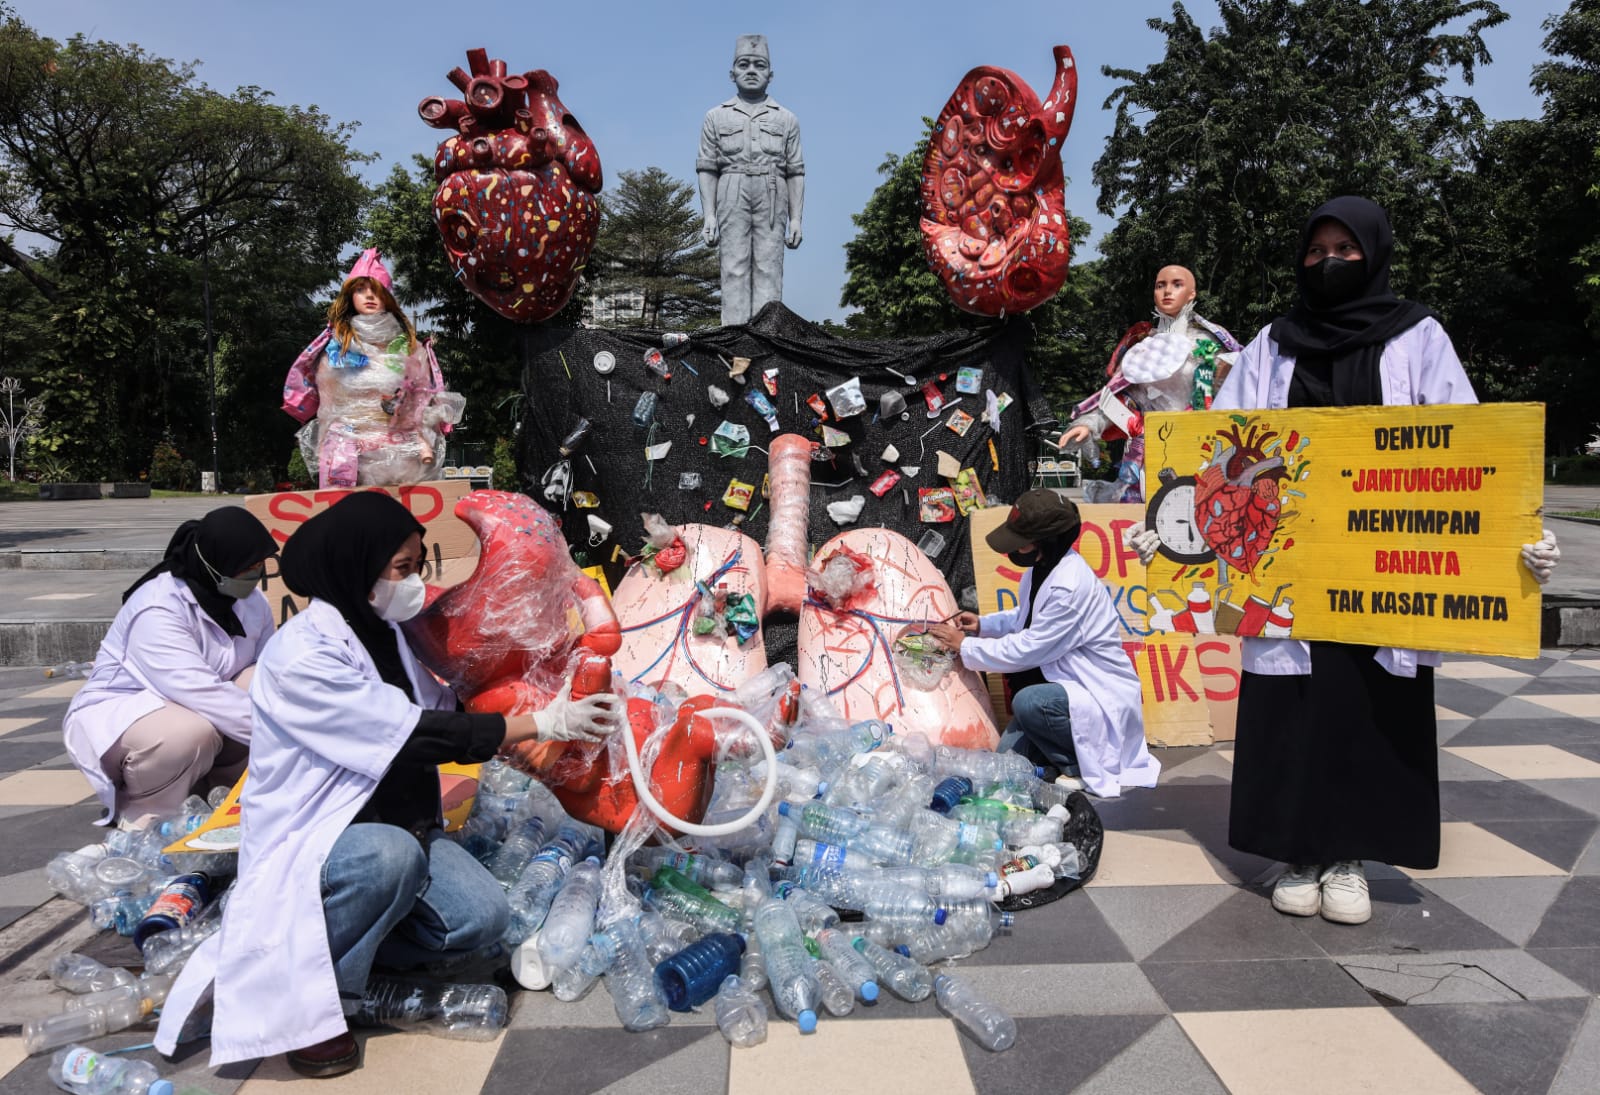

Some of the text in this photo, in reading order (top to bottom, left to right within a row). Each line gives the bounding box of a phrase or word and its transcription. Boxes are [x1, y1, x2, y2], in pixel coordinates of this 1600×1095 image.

[1375, 424, 1454, 450] DENYUT
[1341, 466, 1496, 492] “JANTUNGMU”
[1348, 509, 1480, 534] MENYIMPAN
[1375, 550, 1460, 576] BAHAYA
[1327, 589, 1508, 621] TAK KASAT MATA
